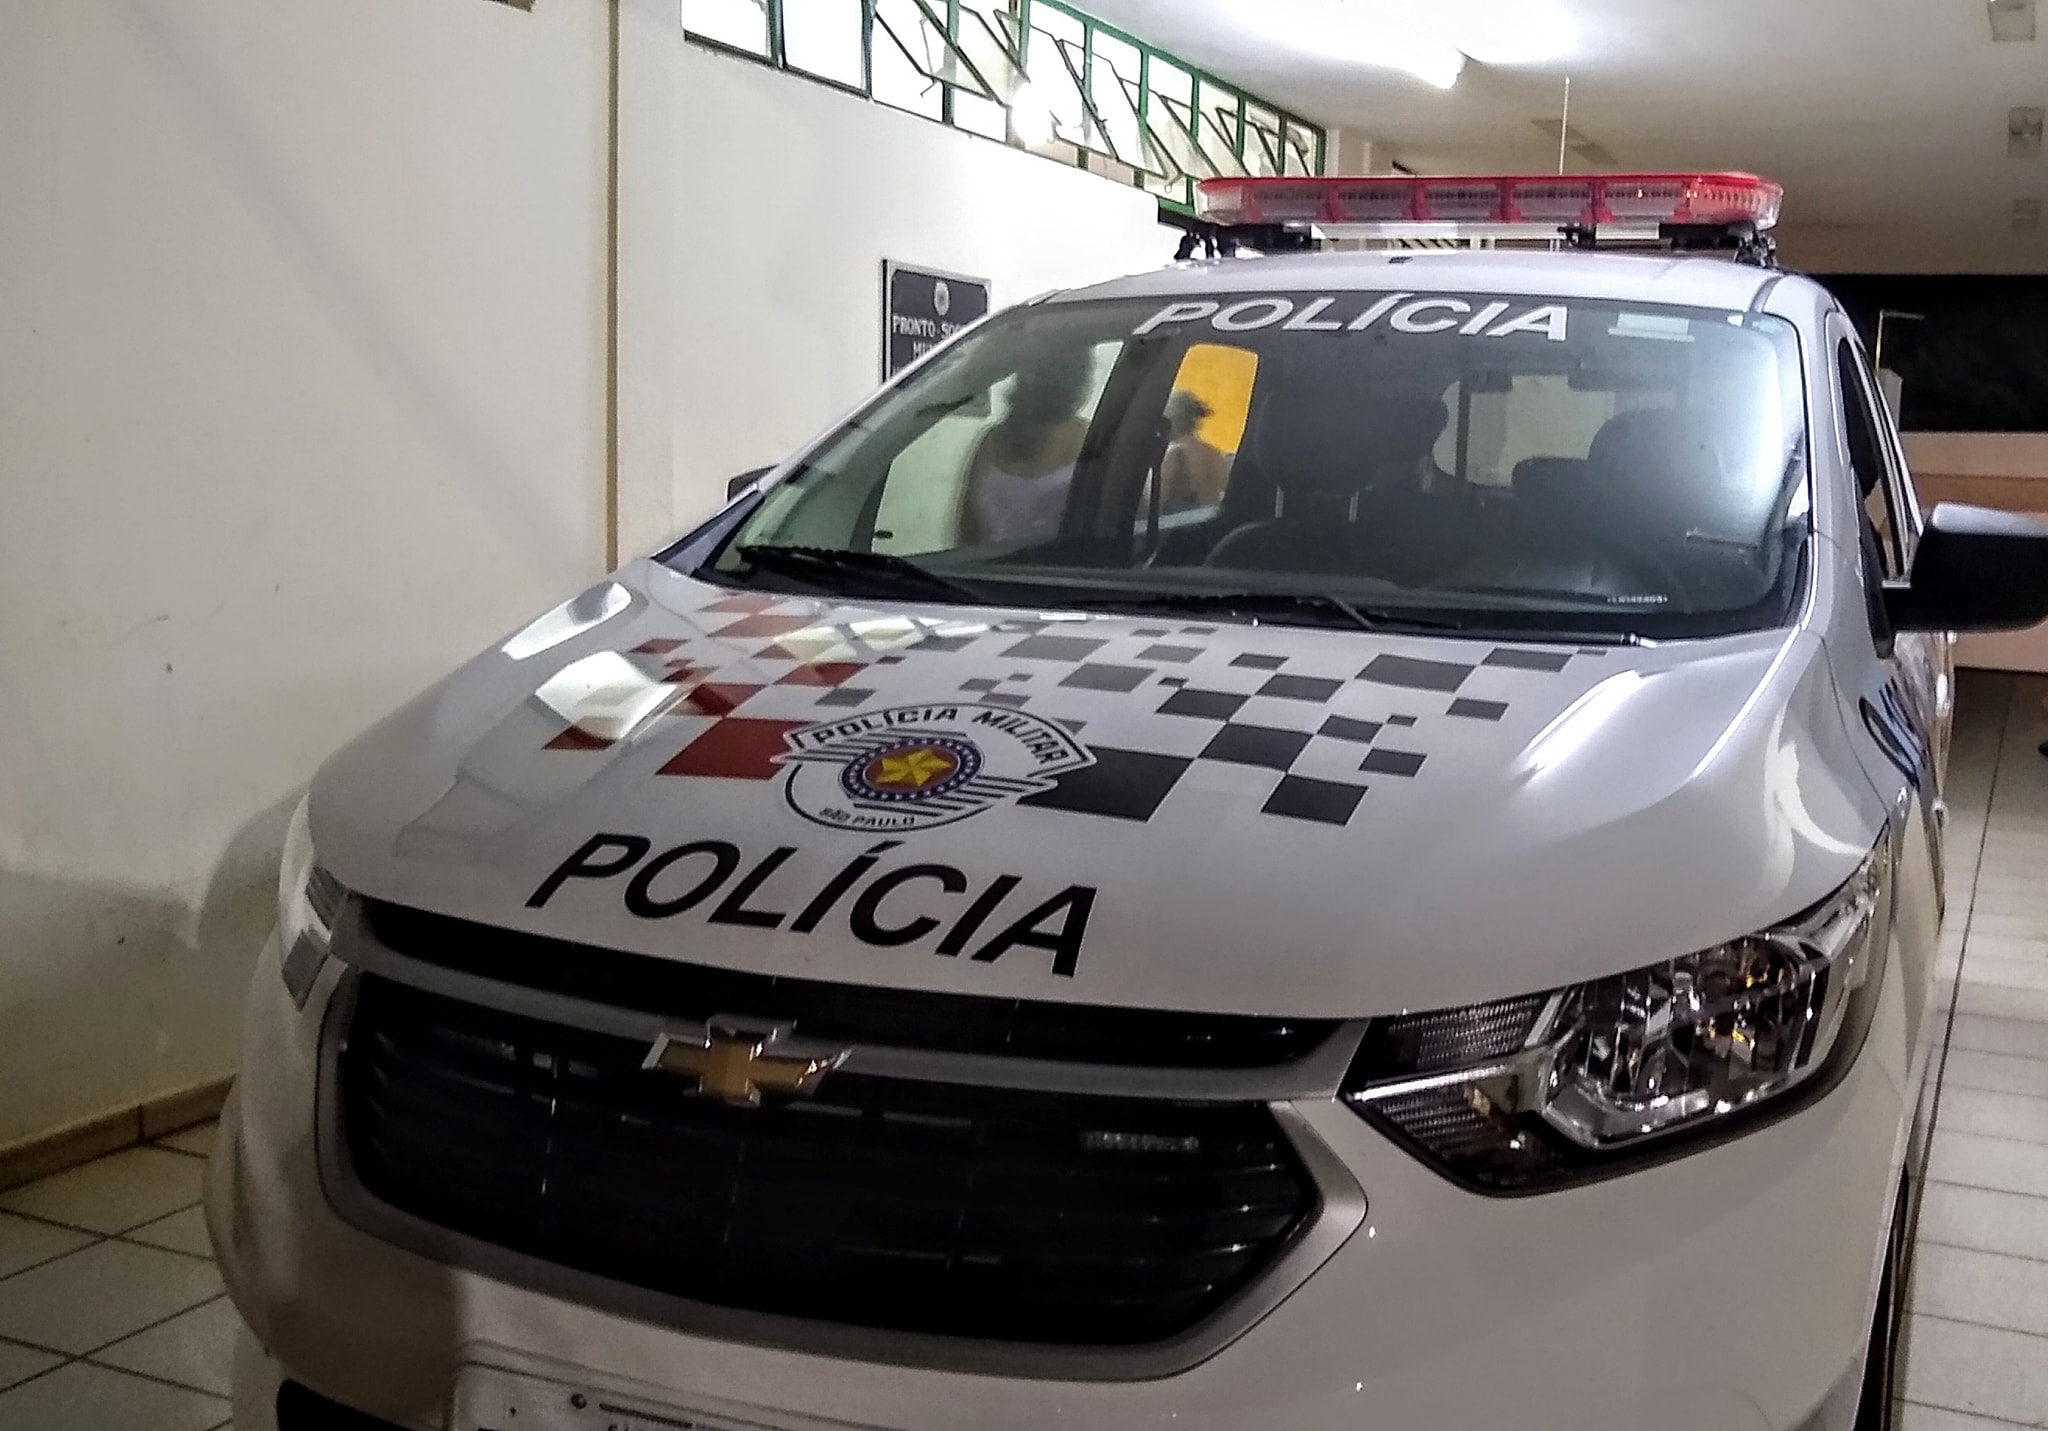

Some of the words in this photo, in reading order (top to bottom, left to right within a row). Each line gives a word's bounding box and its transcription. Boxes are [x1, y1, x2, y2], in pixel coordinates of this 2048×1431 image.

[892, 314, 936, 338] PRONTO
[1131, 292, 1569, 342] POLÍCIA
[812, 708, 958, 744] POLÍCIA
[971, 710, 1070, 765] MILITAR
[852, 815, 916, 827] PAULO
[524, 832, 1098, 979] POLÍCIA
